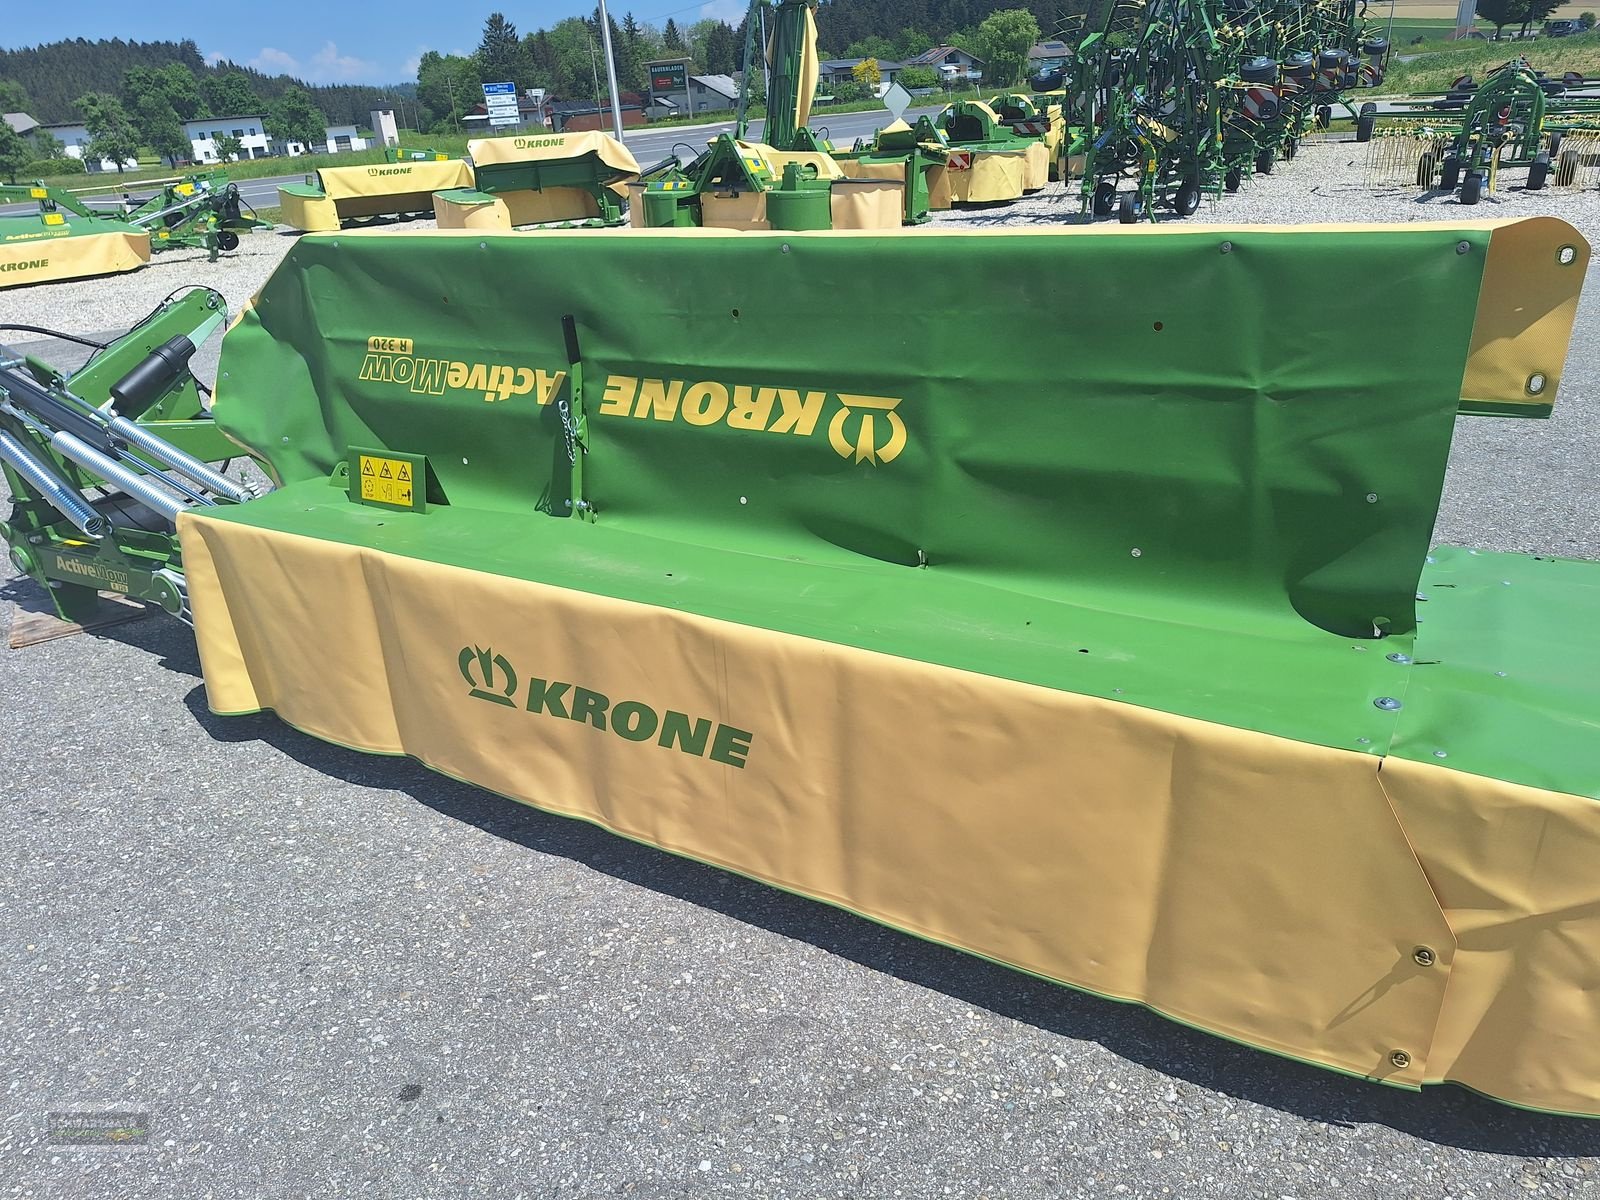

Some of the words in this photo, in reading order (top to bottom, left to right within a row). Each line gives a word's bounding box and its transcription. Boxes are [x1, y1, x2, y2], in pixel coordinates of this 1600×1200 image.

[527, 138, 564, 148] KRONE
[379, 167, 412, 176] KRONE
[373, 338, 395, 351] 320
[400, 340, 407, 352] R
[599, 374, 827, 436] KRONE
[526, 677, 753, 769] KRONE
